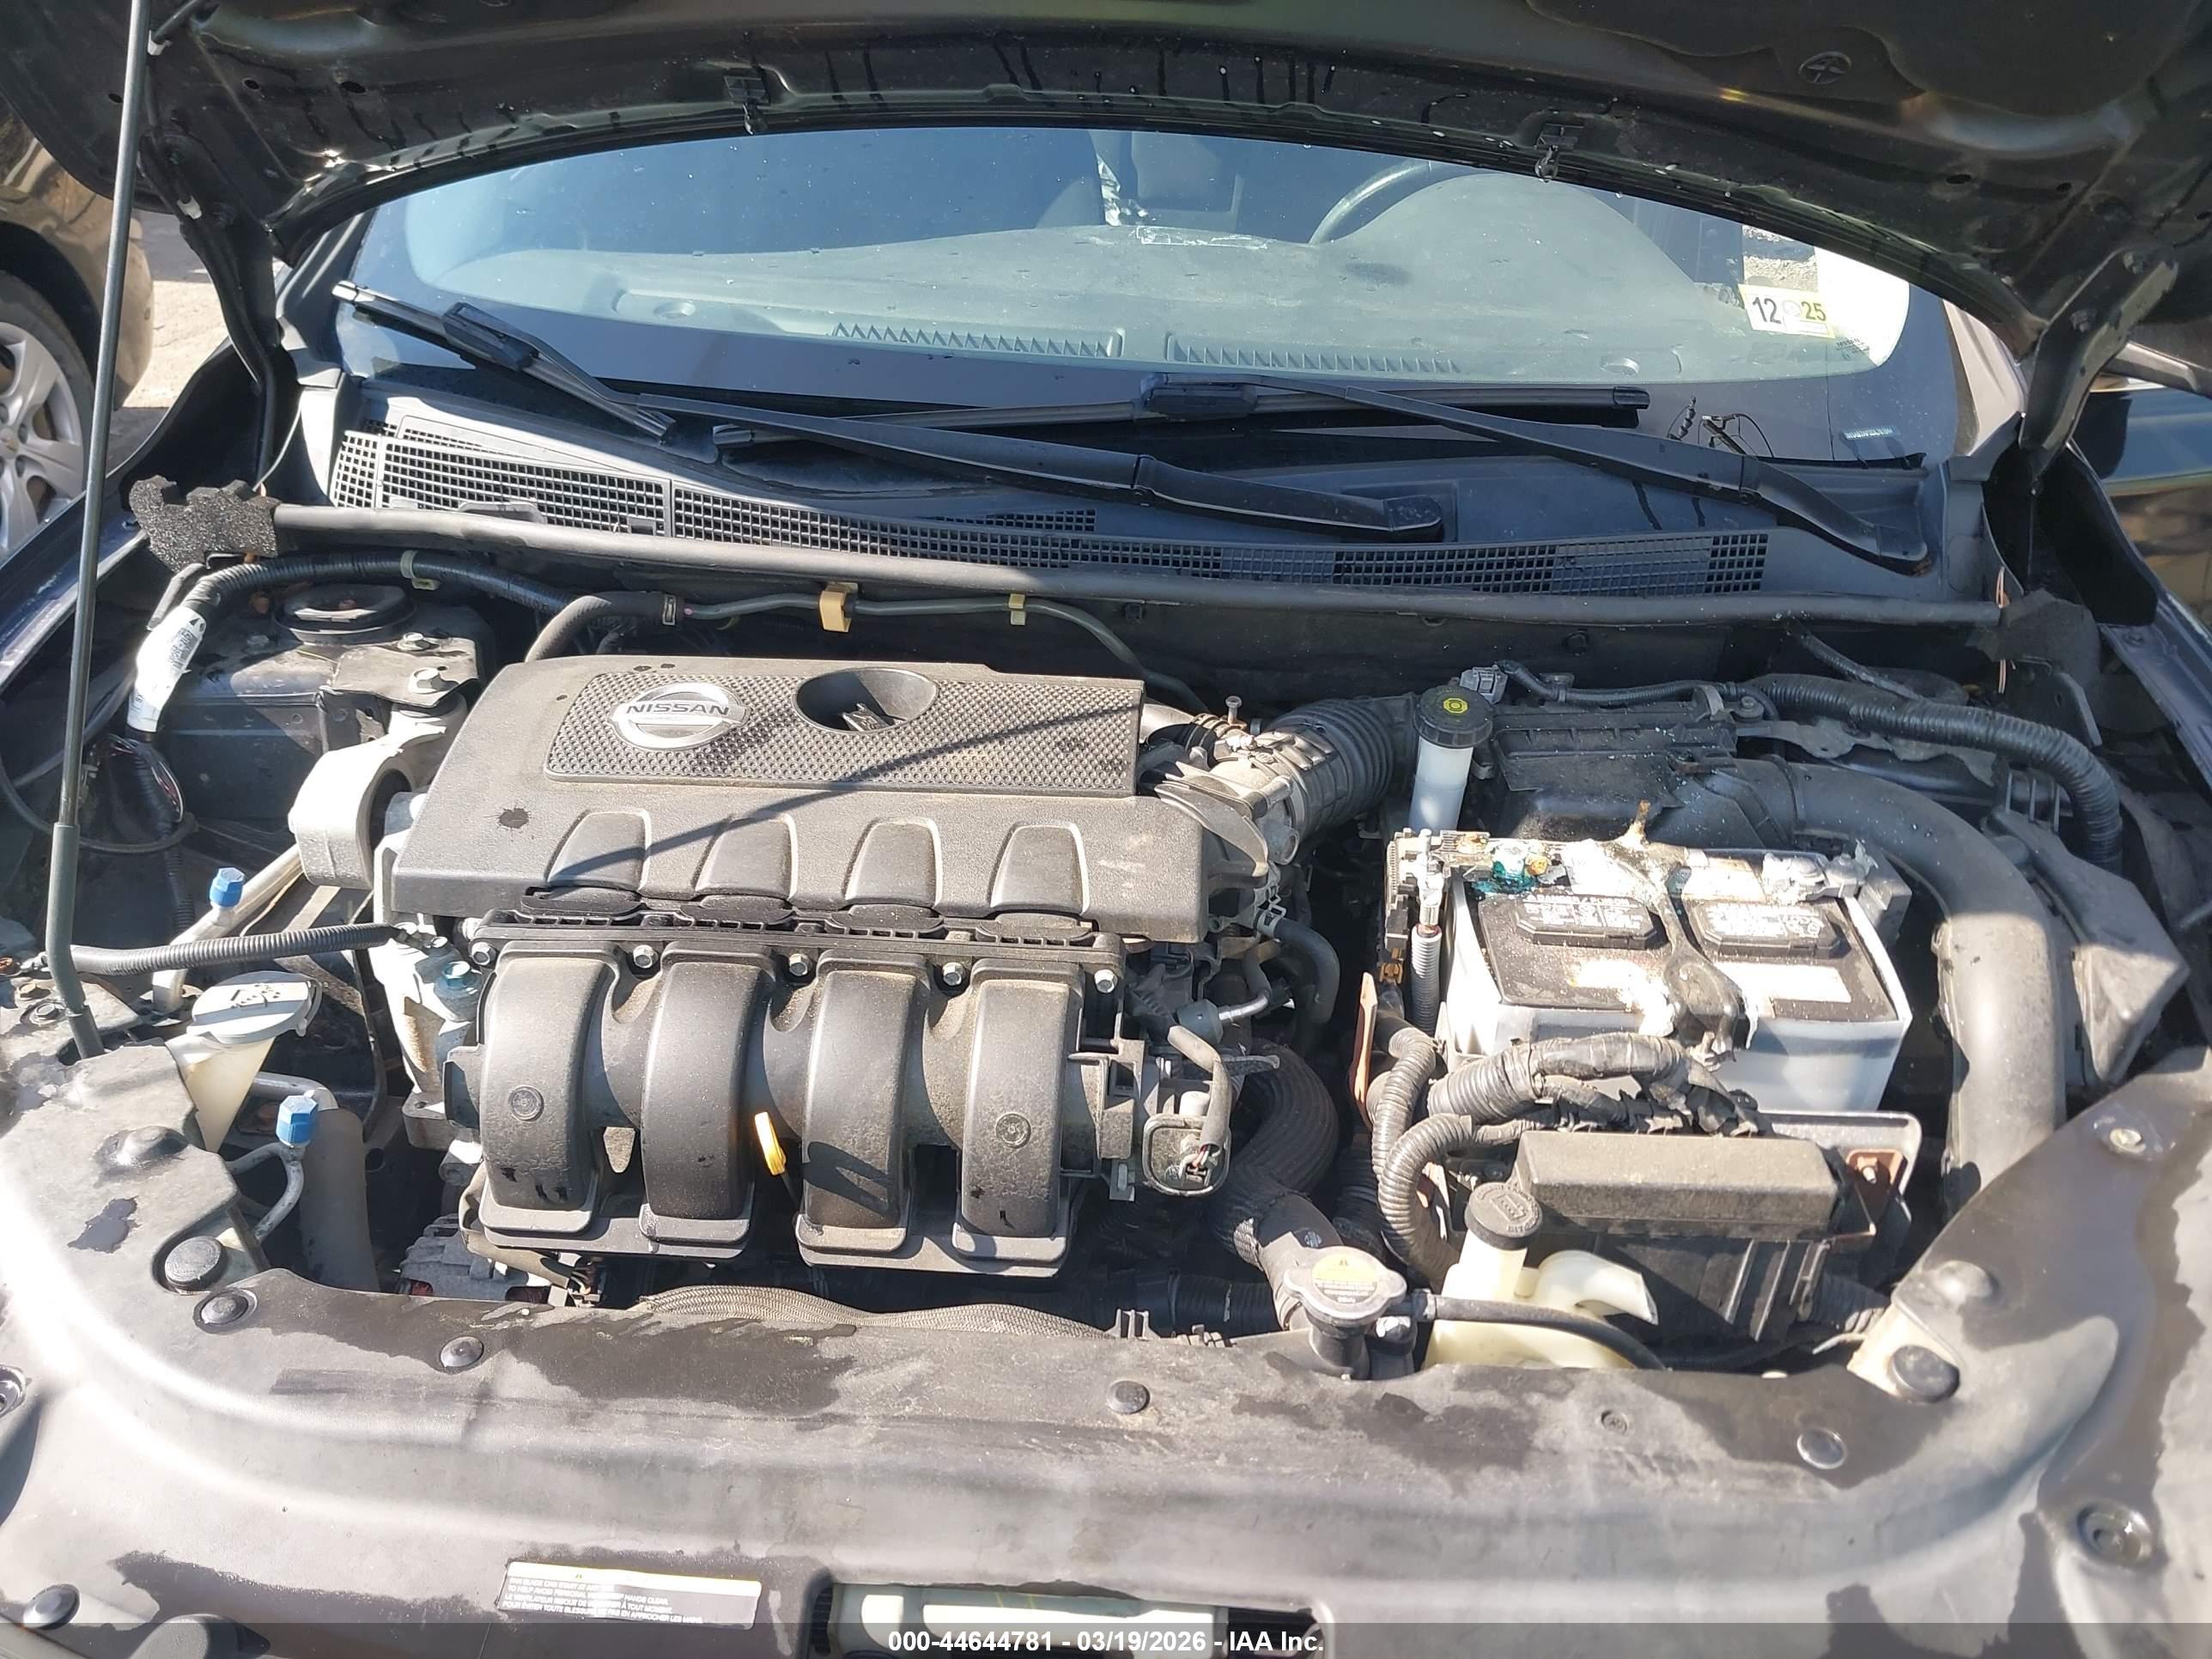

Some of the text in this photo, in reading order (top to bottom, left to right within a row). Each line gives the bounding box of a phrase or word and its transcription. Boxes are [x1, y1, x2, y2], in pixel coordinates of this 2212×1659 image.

[1752, 296, 1826, 325] 12 25
[626, 703, 730, 715] NISSAN
